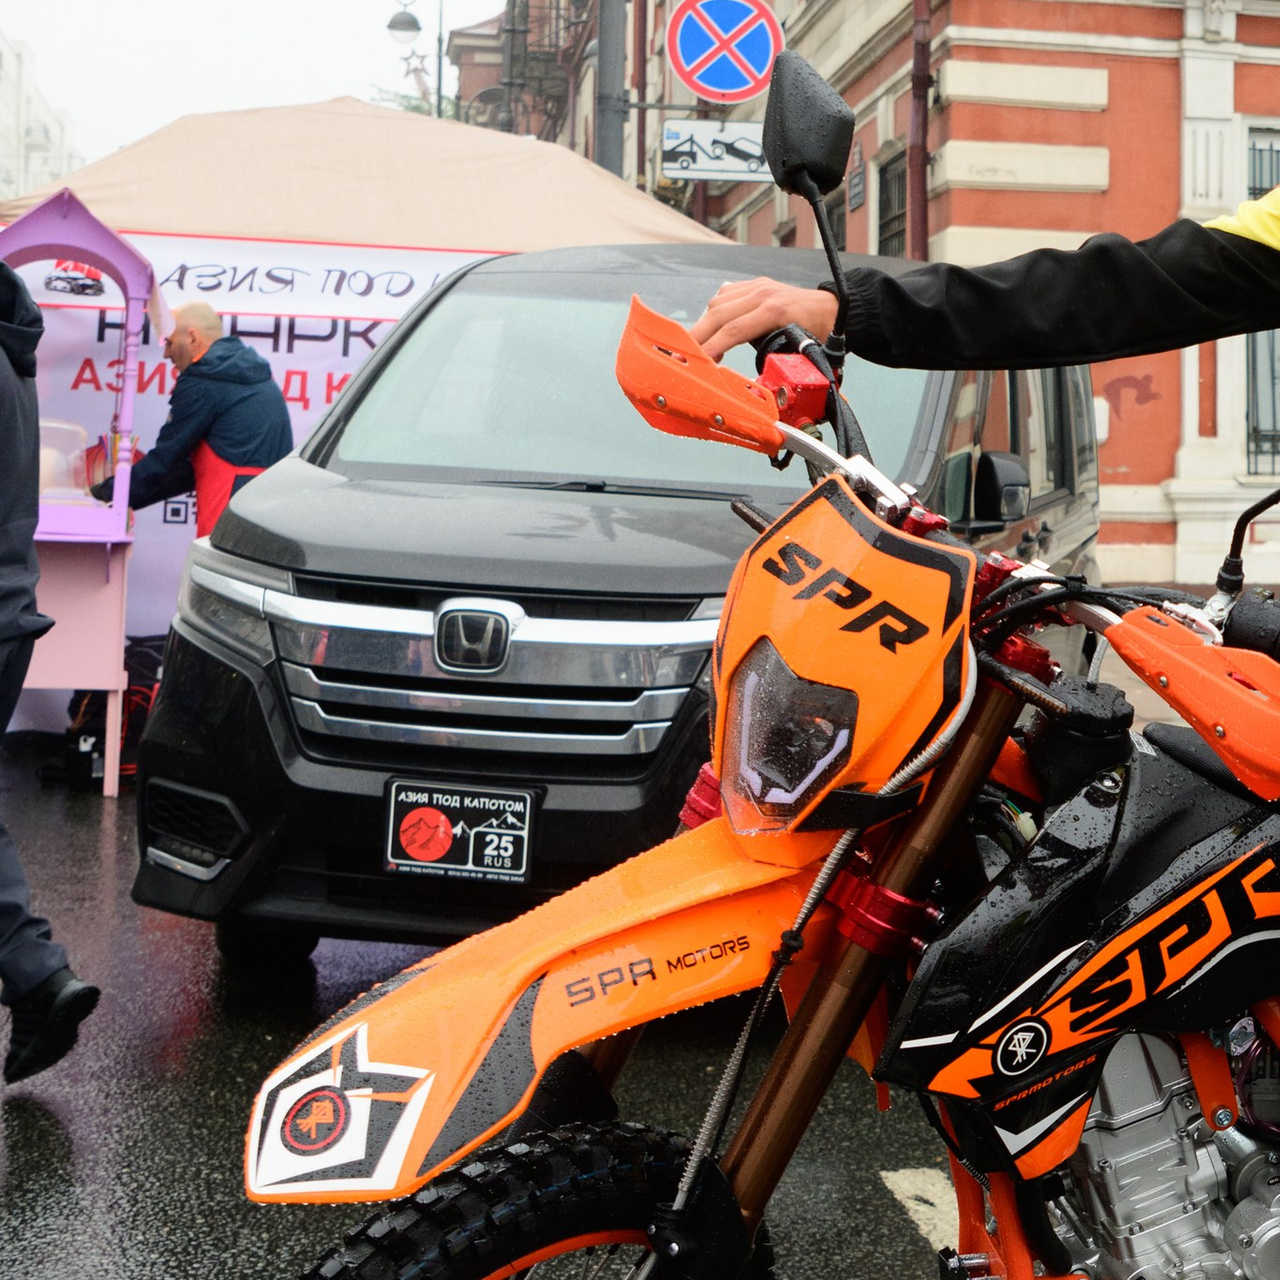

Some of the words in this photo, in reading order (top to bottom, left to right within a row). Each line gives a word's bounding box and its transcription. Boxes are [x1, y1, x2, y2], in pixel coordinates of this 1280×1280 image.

[159, 263, 310, 294] АЗИЯ
[321, 268, 415, 297] ПОД
[761, 542, 930, 654] SPR
[398, 791, 429, 804] АЗИЯ
[432, 793, 460, 808] ПОД
[463, 797, 525, 813] КАПОТОМ
[483, 834, 514, 857] 25
[484, 856, 512, 868] RUS
[565, 957, 657, 1008] SPR
[666, 935, 750, 974] MOTORS
